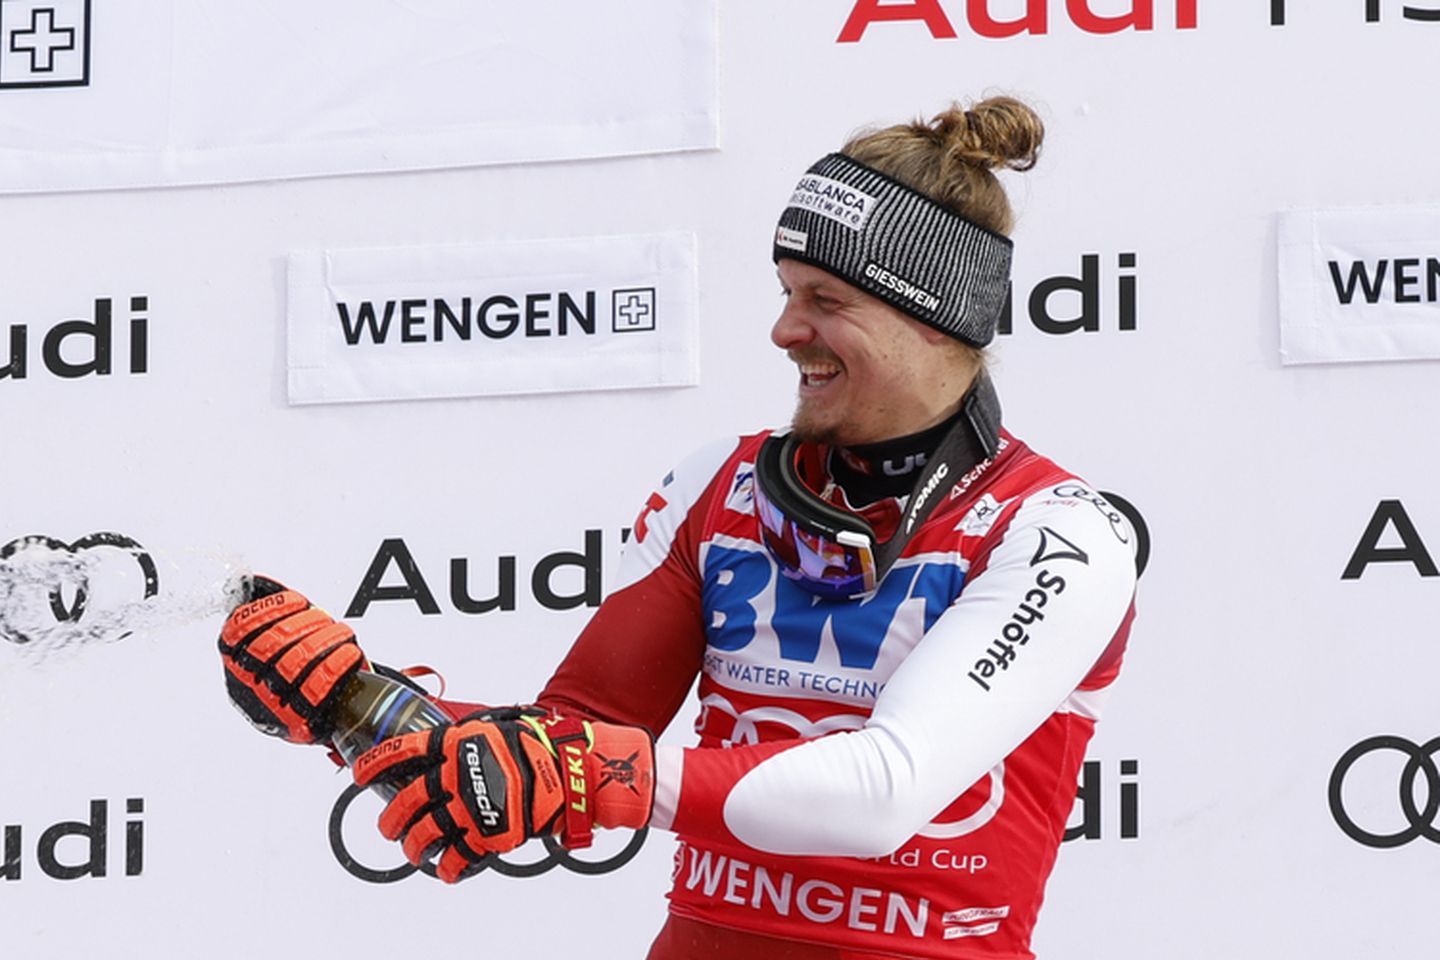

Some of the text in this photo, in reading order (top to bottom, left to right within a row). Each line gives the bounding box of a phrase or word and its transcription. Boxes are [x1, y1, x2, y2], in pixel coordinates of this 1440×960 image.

[336, 291, 596, 346] WENGEN
[864, 263, 941, 313] GIESSWEIN
[967, 568, 1066, 692] Schöffel
[727, 661, 790, 688] WATER
[465, 742, 500, 826] reusch
[565, 745, 589, 813] LEKI
[931, 849, 989, 873] Cup
[686, 846, 930, 938] WENGEN
